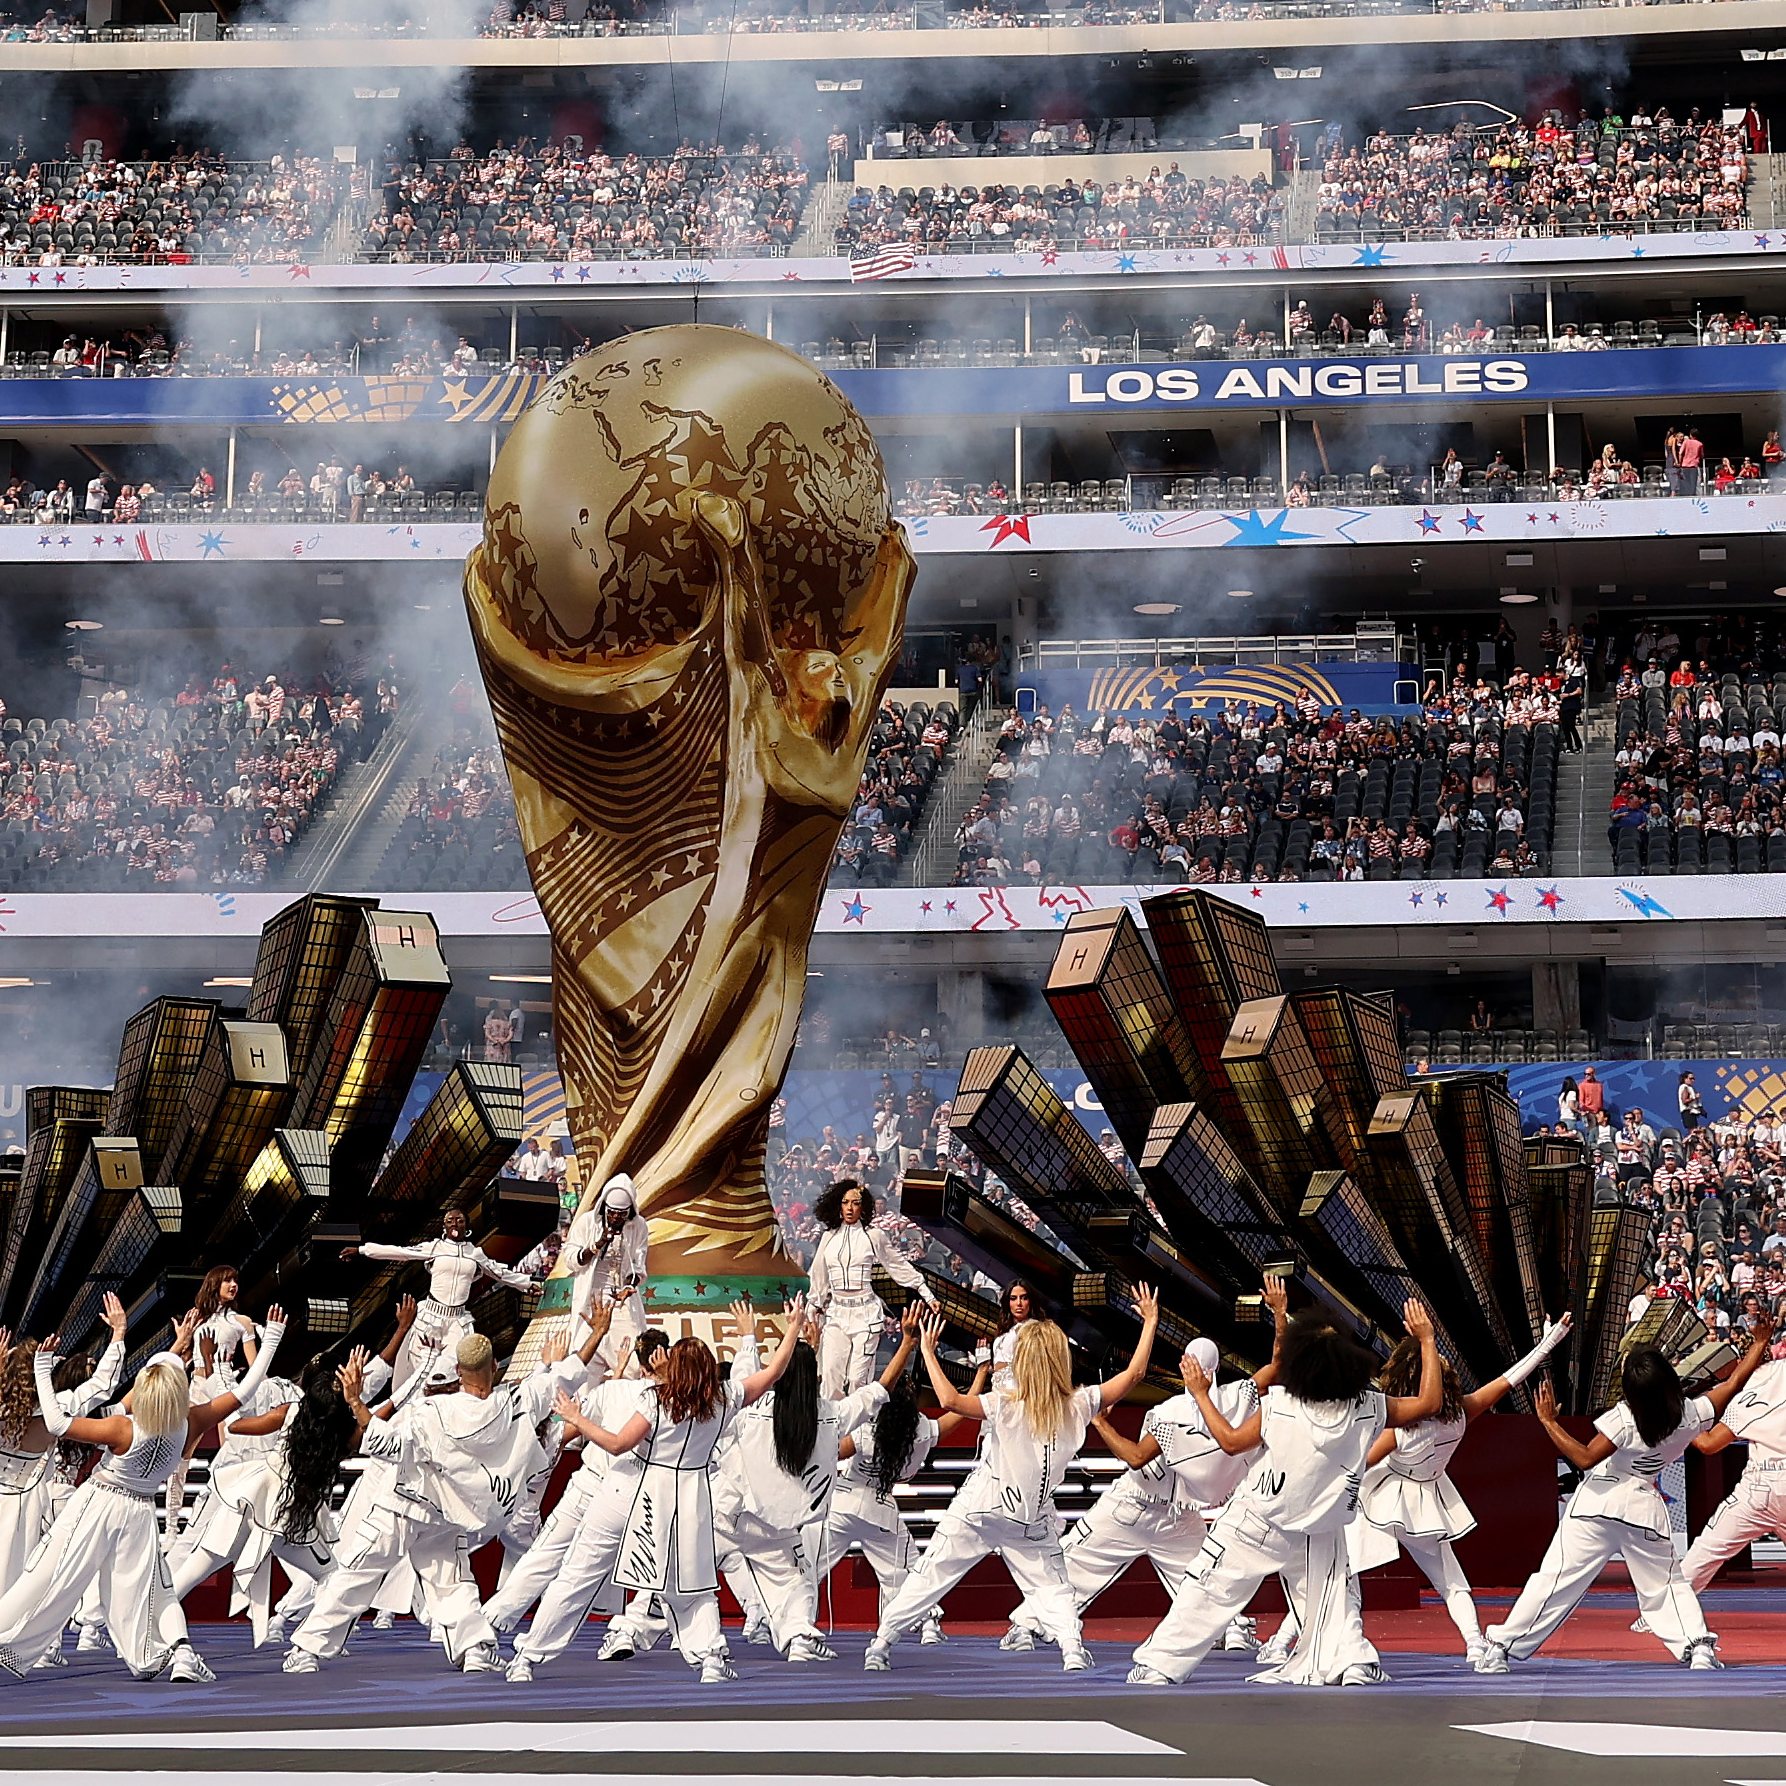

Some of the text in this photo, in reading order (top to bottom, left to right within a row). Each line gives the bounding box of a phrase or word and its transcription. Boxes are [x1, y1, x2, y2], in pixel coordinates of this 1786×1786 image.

[1068, 360, 1530, 404] LOS ANGELES
[398, 925, 416, 949] H
[1069, 947, 1089, 971] H
[1239, 1025, 1257, 1045] H
[249, 1047, 266, 1069] H
[1383, 1109, 1395, 1124] H
[114, 1162, 128, 1181] H
